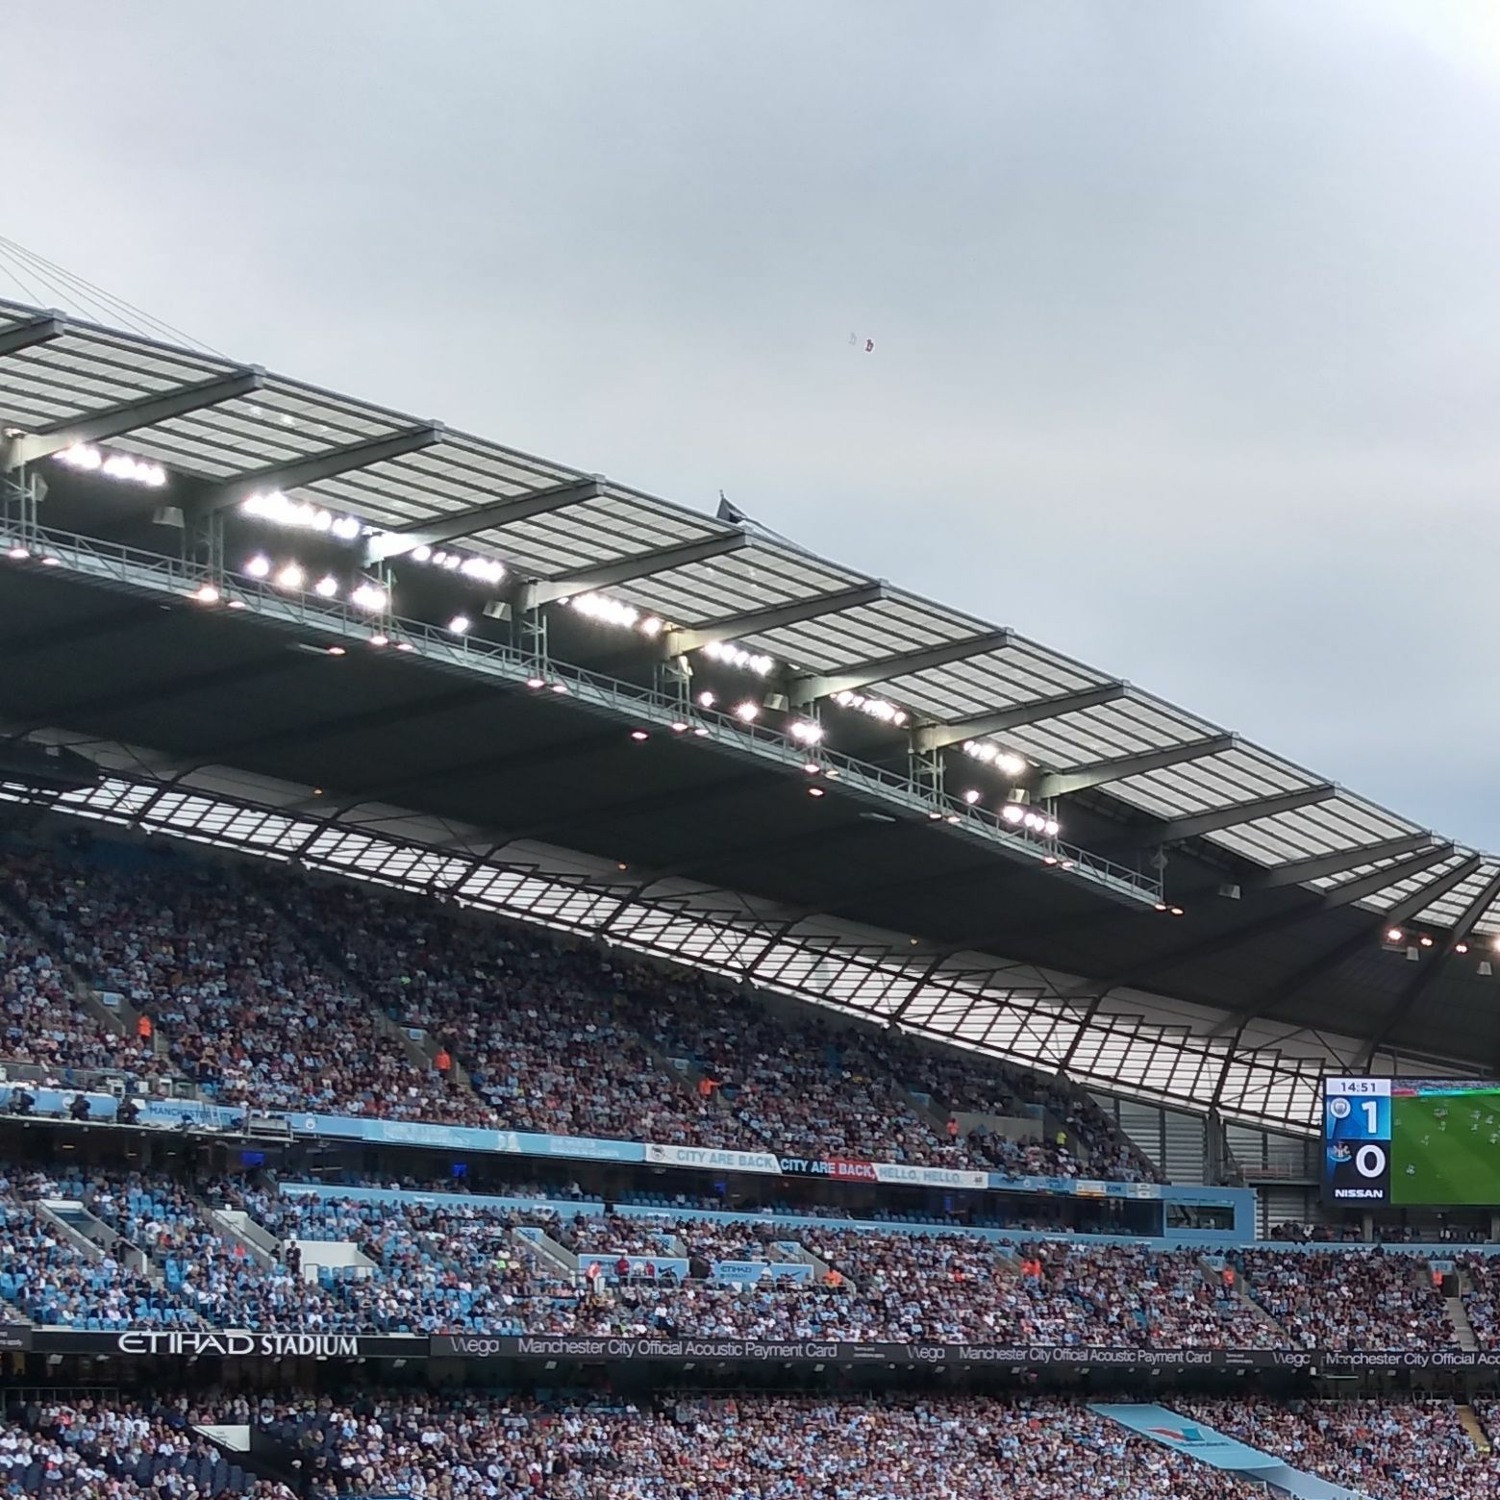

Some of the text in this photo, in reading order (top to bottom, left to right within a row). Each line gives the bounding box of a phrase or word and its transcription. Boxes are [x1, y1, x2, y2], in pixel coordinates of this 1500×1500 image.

[1340, 1082, 1377, 1092] 14:51
[1361, 1100, 1378, 1135] 1
[677, 1149, 706, 1162] CITY
[709, 1153, 734, 1166] ARE
[1355, 1144, 1387, 1178] 0
[781, 1158, 875, 1180] CITY ARE BACK,
[1334, 1188, 1384, 1199] NISSAN
[118, 1331, 359, 1356] ETIHAD STADIUM
[518, 1337, 605, 1355] Manchester
[608, 1339, 636, 1358] City
[638, 1339, 683, 1355] Official
[685, 1341, 743, 1357] Acoustic
[745, 1342, 804, 1360] Payment
[806, 1342, 838, 1358] Card
[959, 1346, 1027, 1360] Manchester
[1029, 1347, 1051, 1363] City
[1052, 1347, 1088, 1361] Official
[1089, 1350, 1136, 1362] Acoustic
[1137, 1350, 1184, 1366] Payment
[1185, 1350, 1212, 1363] Card
[1404, 1352, 1429, 1368] City
[1431, 1352, 1475, 1365] Official
